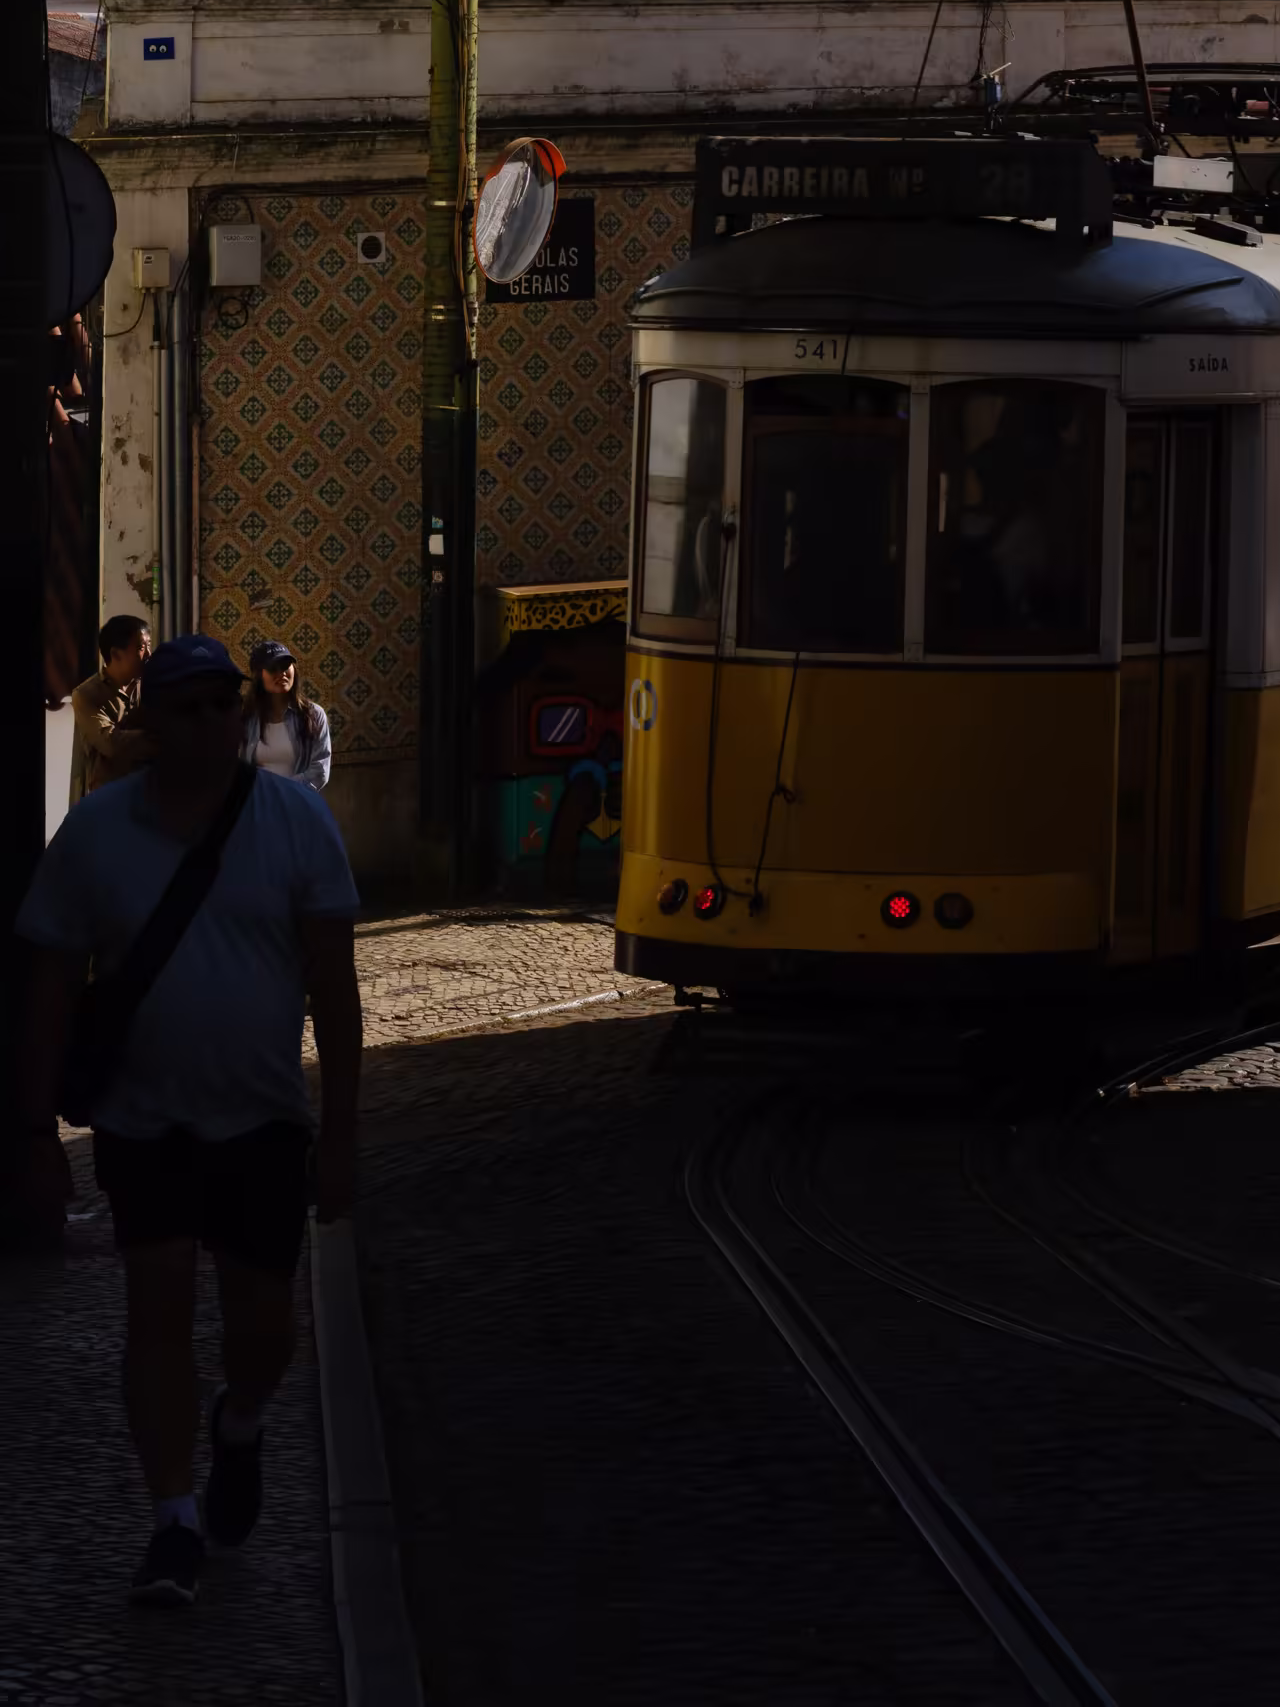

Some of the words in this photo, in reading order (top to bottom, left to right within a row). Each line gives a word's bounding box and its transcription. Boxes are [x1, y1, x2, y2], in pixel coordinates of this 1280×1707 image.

[721, 165, 869, 197] CARREIRA
[535, 247, 579, 268] OLAS
[509, 273, 570, 296] GERAIS
[795, 339, 837, 360] 541
[1189, 353, 1229, 372] SAÍDA
